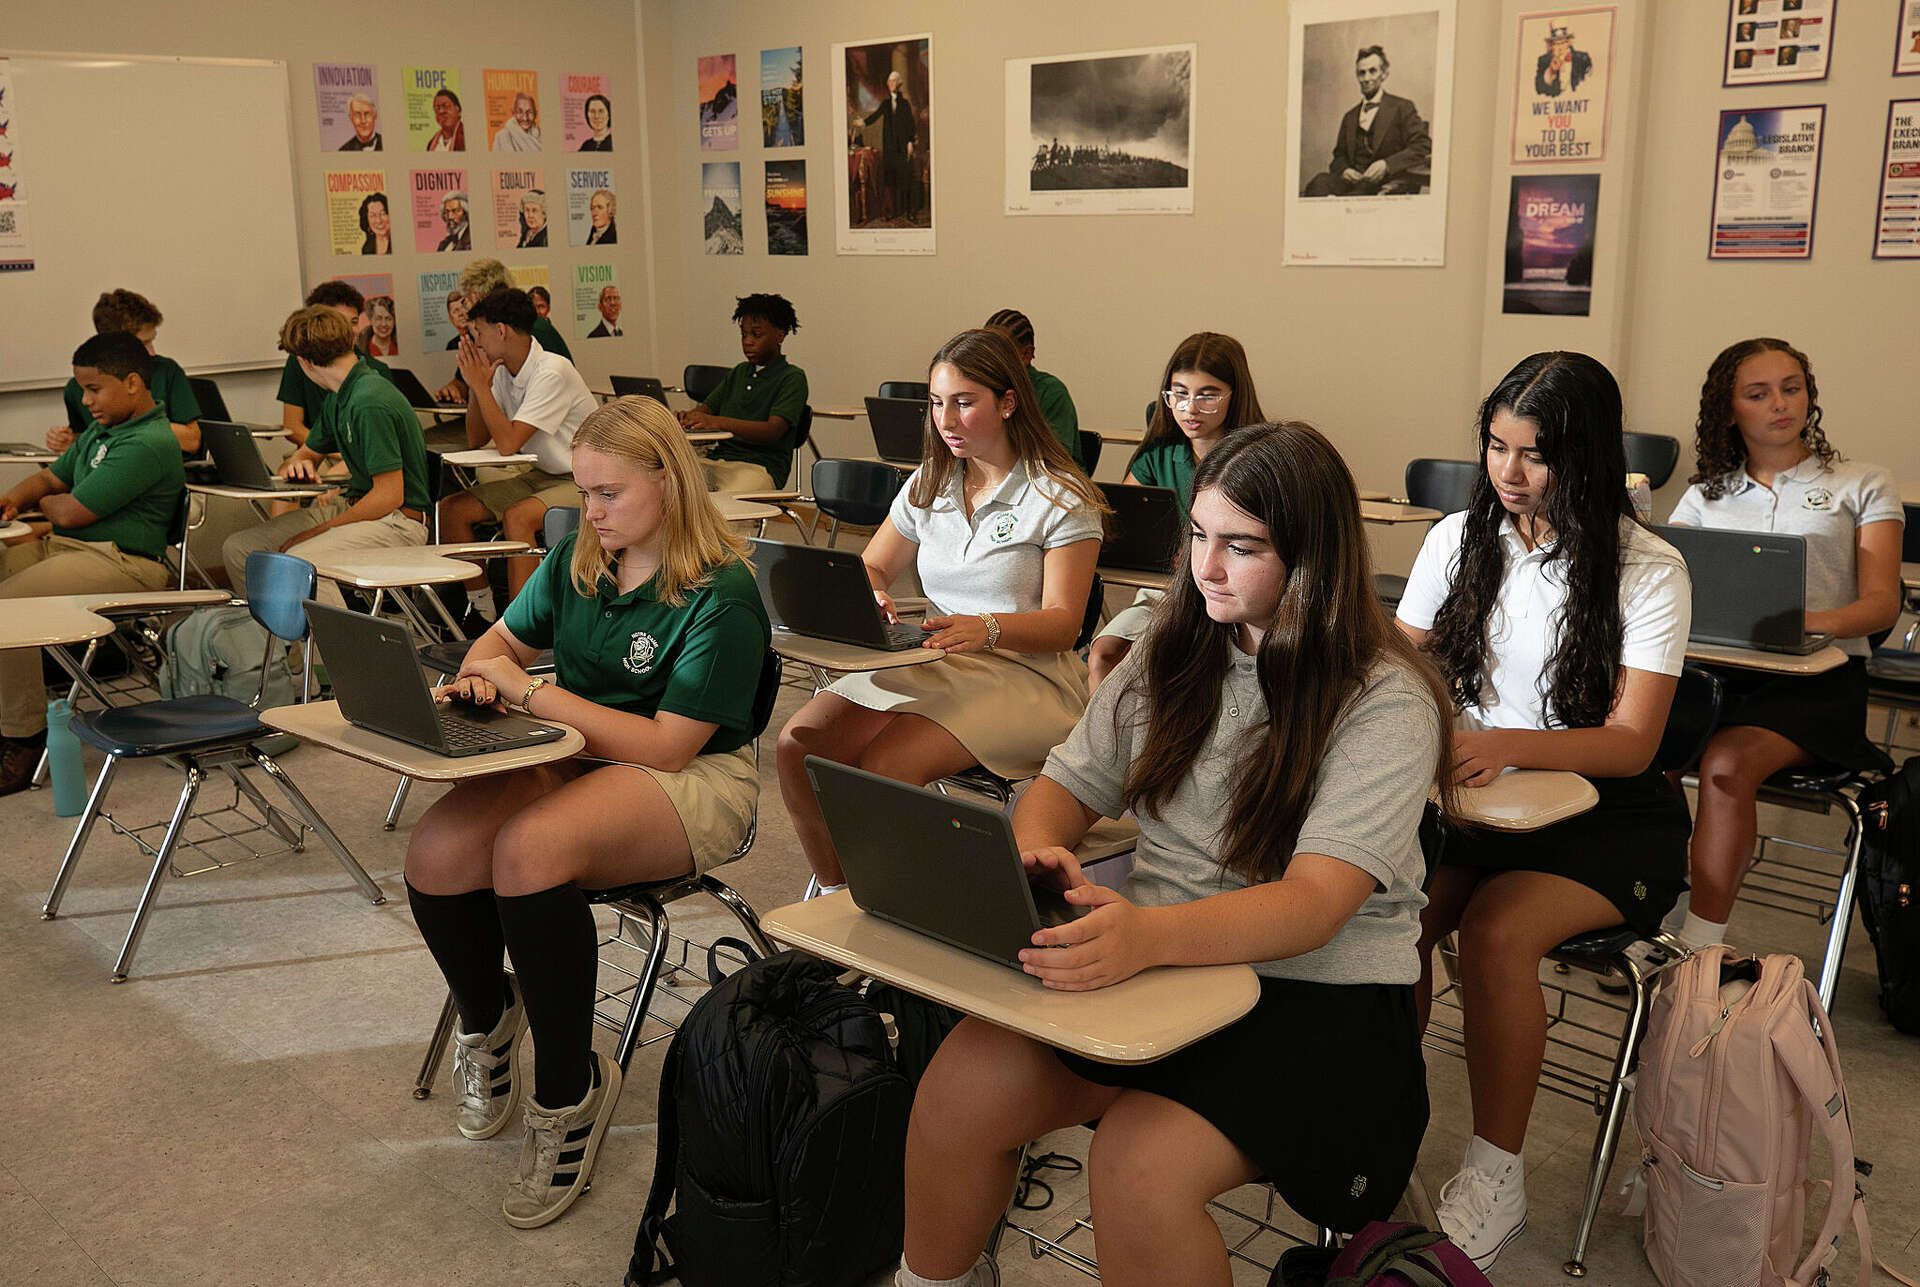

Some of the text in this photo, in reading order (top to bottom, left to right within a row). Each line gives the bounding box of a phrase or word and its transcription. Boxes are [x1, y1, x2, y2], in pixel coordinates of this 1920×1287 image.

[318, 66, 373, 87] INNOVATION
[415, 69, 447, 89] HOPE
[487, 71, 535, 91] HUMILITY
[1532, 99, 1590, 116] WE WANT
[1547, 115, 1572, 129] YOU
[1801, 121, 1816, 132] THE
[1895, 116, 1913, 127] THE
[1541, 128, 1575, 143] TO DO
[1525, 142, 1591, 158] YOUR BEST
[1778, 143, 1816, 154] BRANCH
[1892, 139, 1920, 150] BRAN
[327, 172, 385, 193] COMPASSION
[415, 172, 462, 191] DIGNITY
[500, 171, 536, 190] EQUALITY
[570, 171, 609, 189] SERVICE
[1526, 202, 1585, 217] DREAM
[578, 264, 612, 283] VISION
